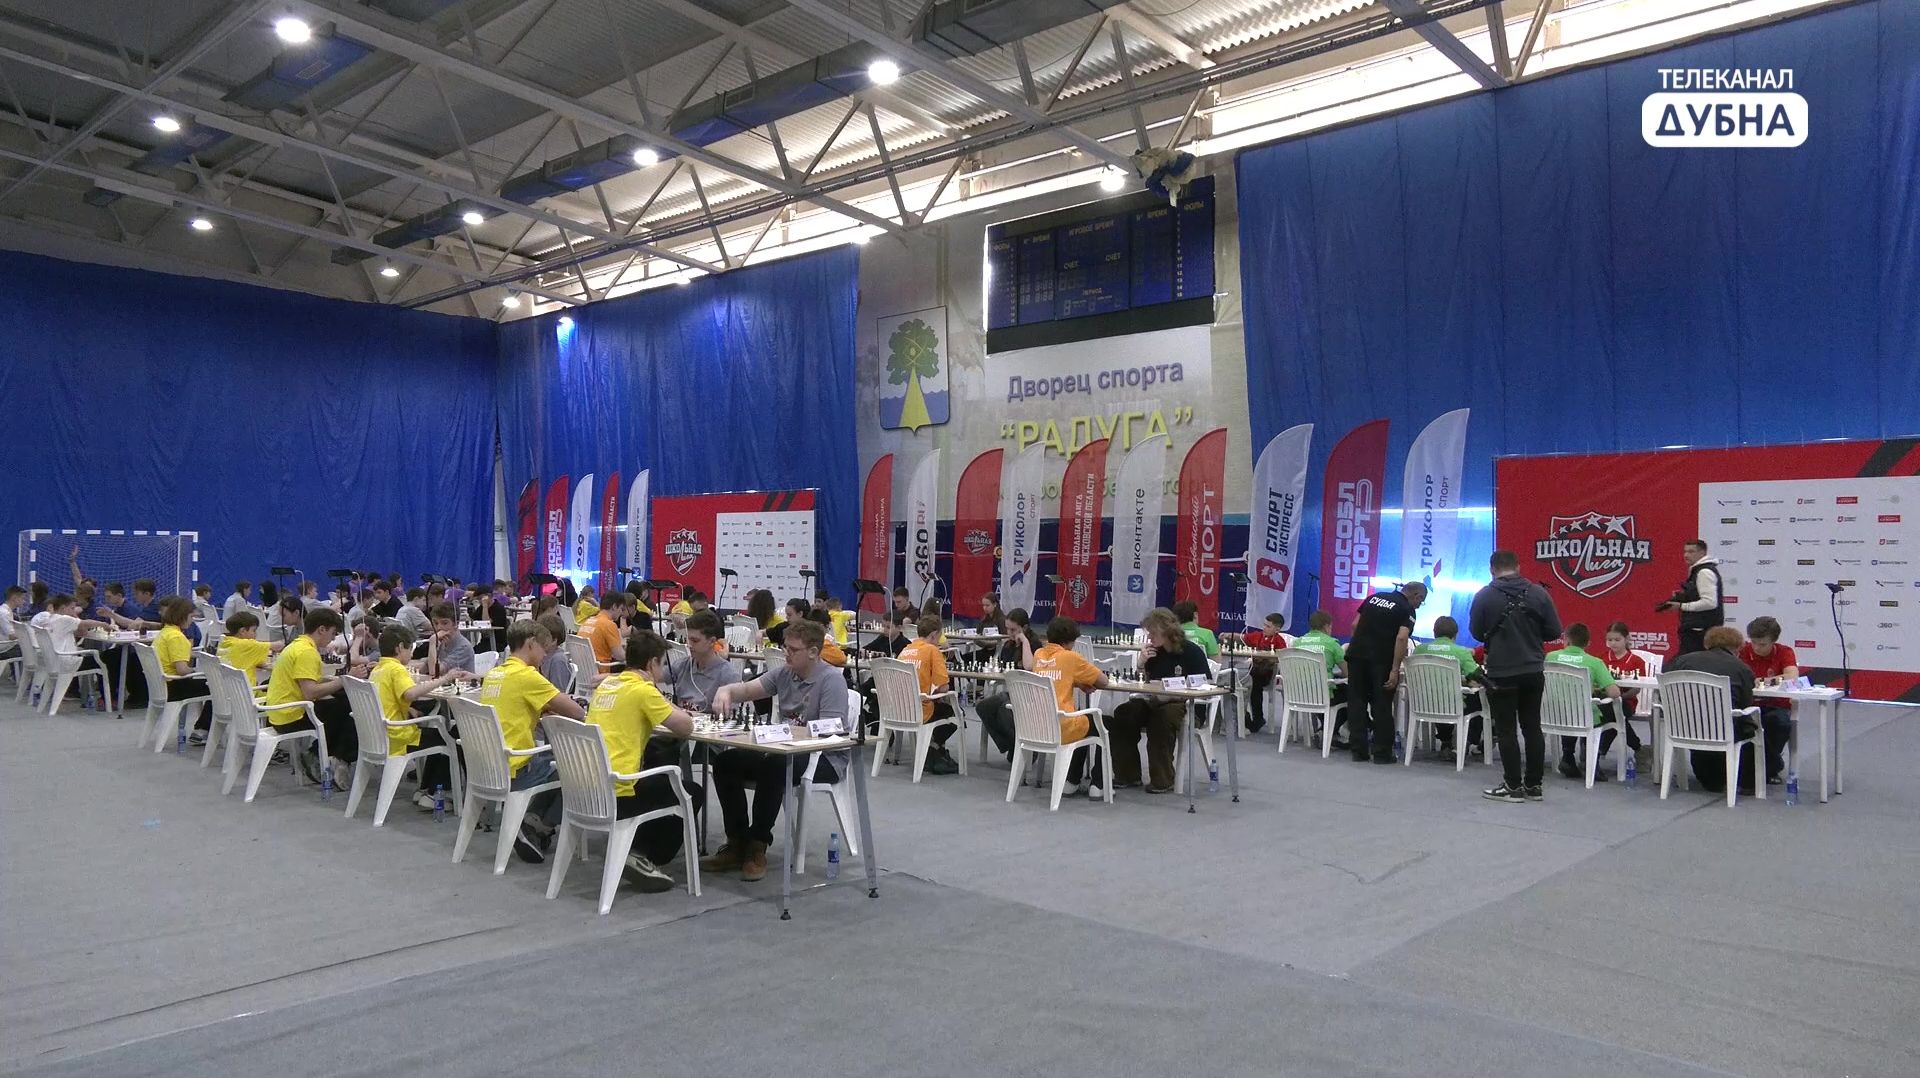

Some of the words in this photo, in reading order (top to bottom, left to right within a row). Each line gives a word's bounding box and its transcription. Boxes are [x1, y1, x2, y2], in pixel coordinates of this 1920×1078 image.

[1007, 373, 1091, 402] Дворец
[1098, 362, 1184, 391] спорта
[1266, 487, 1283, 553] СПОРТ
[1421, 474, 1434, 568] ТРИКОЛОР
[1439, 476, 1449, 508] СПОРТ
[1014, 492, 1026, 565] ТРИКОЛОР
[1200, 483, 1215, 596] СПОРТ
[1279, 493, 1294, 557] ЭКСПРЕСС
[1333, 481, 1355, 599] МОСОБЛ
[1536, 537, 1651, 560] ШКОЛЬНАЯ
[1368, 596, 1396, 610] СУДЬЯ
